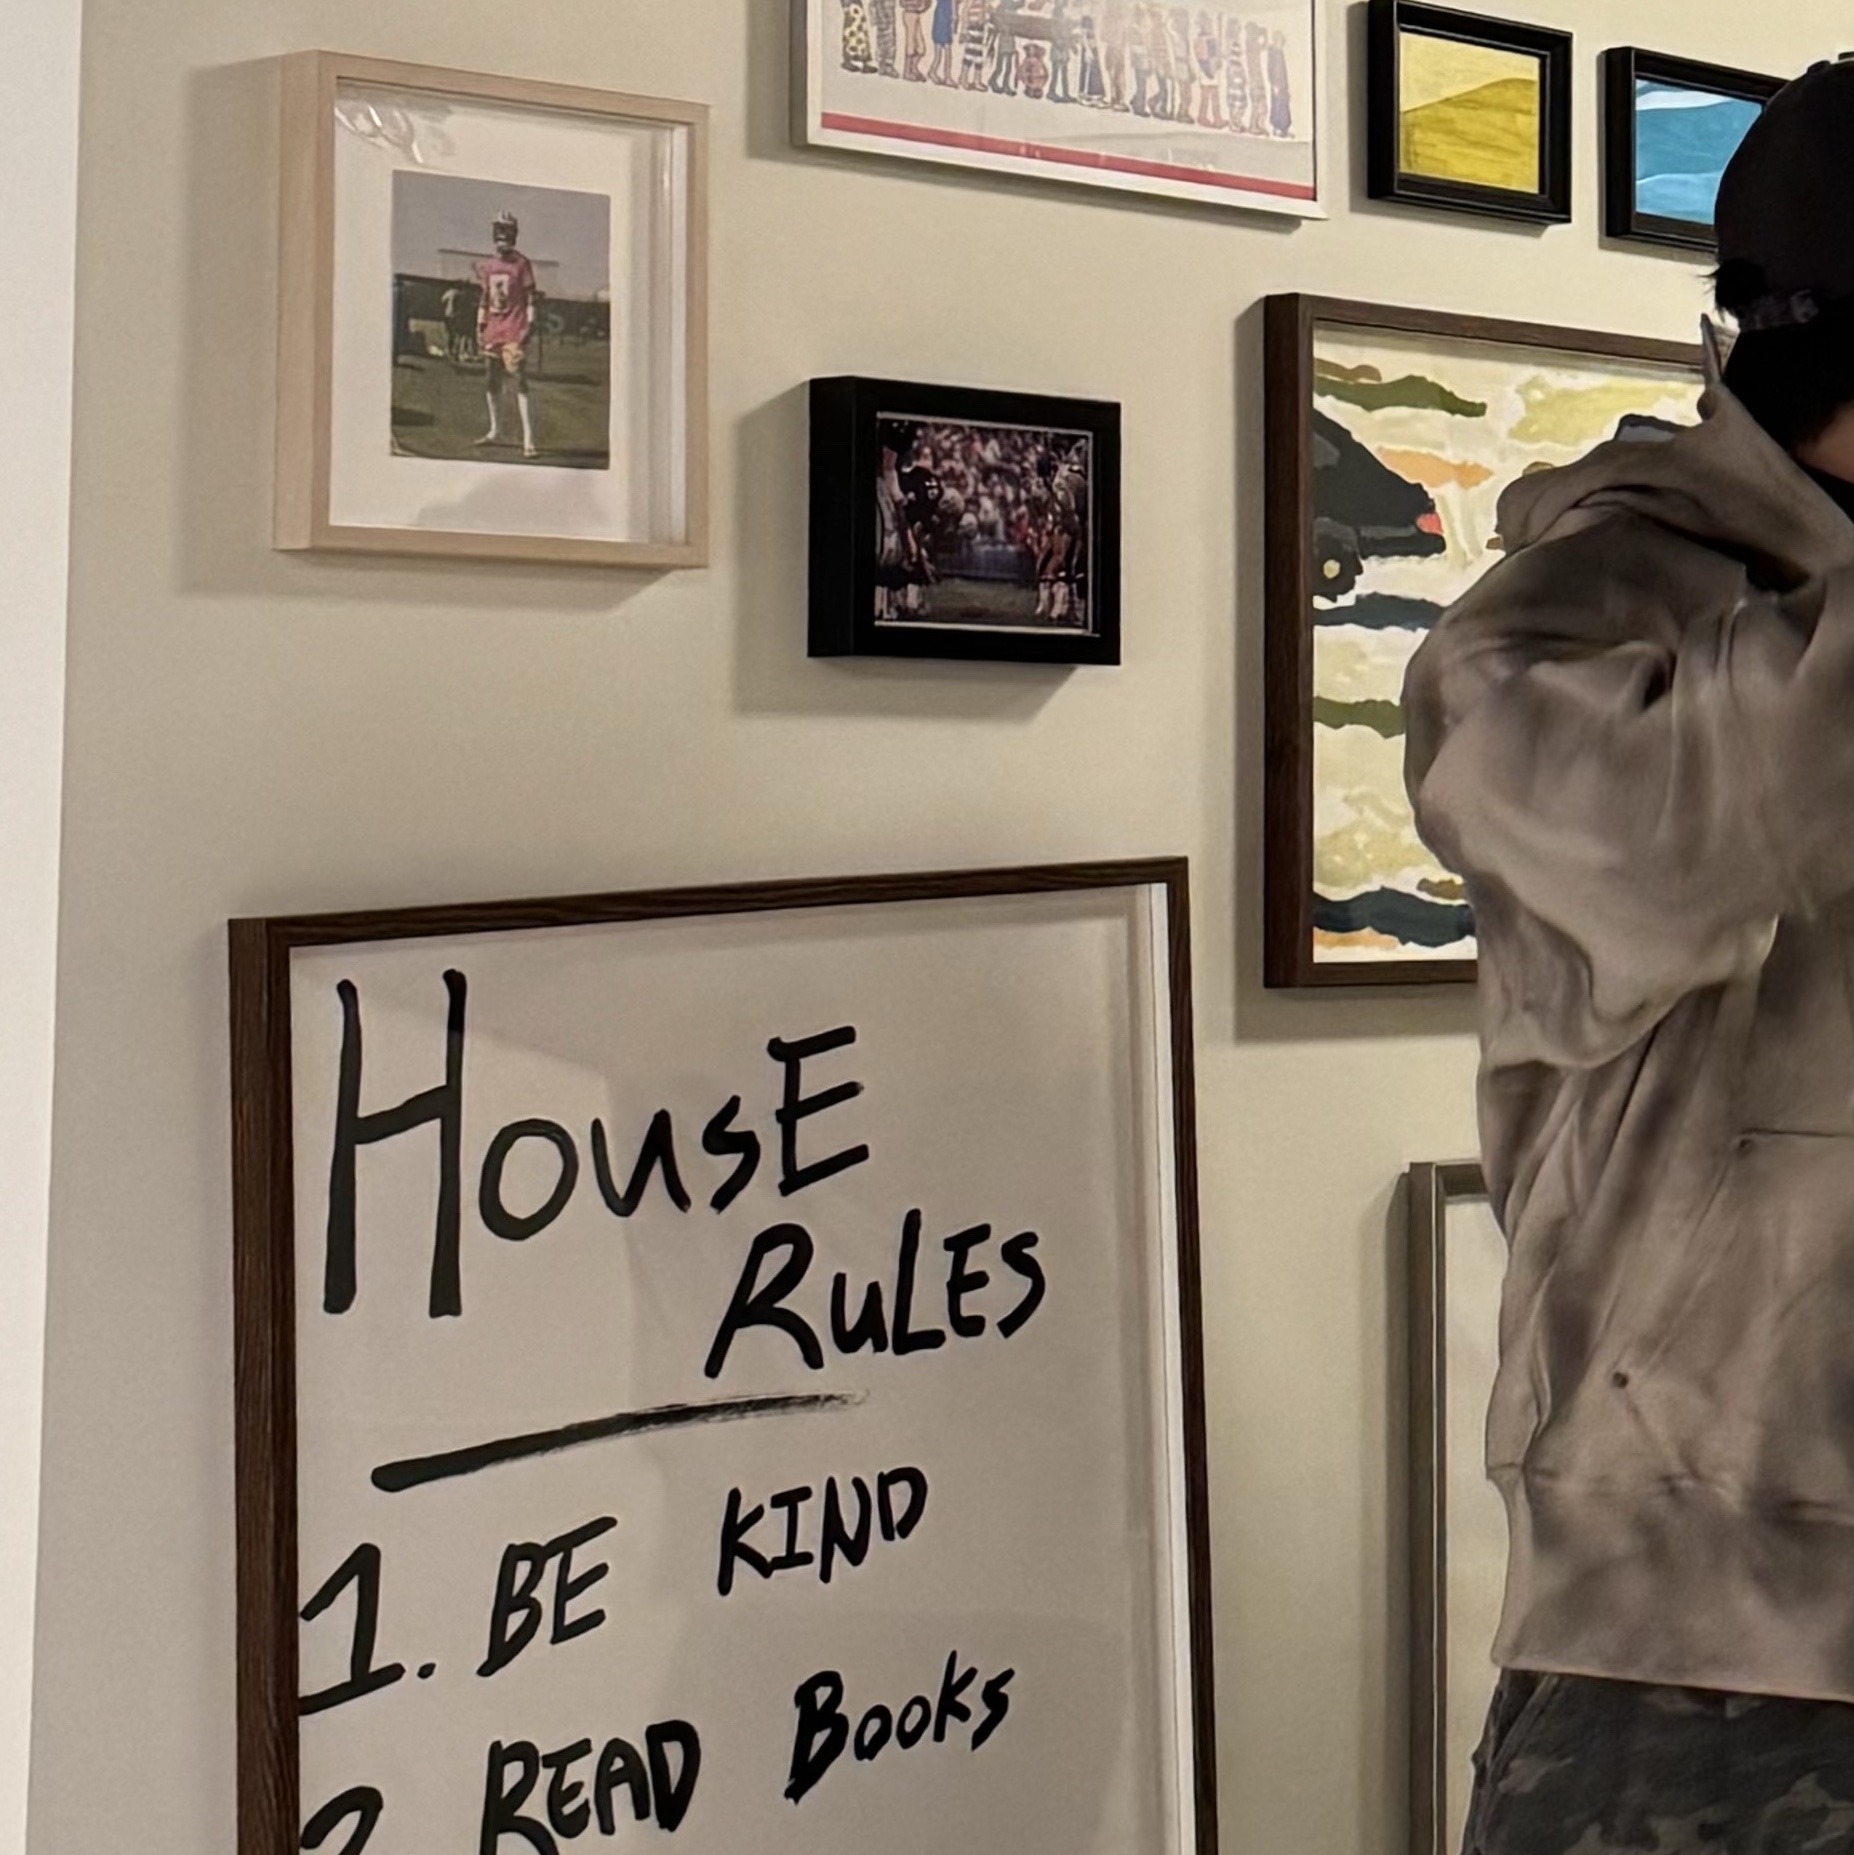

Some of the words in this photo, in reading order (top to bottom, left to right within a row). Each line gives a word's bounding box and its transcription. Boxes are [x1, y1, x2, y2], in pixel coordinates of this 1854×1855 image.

[298, 1543, 437, 1717] 1.
[476, 1516, 618, 1678] BE
[717, 1466, 928, 1597] KIND
[783, 1650, 1016, 1806] Books
